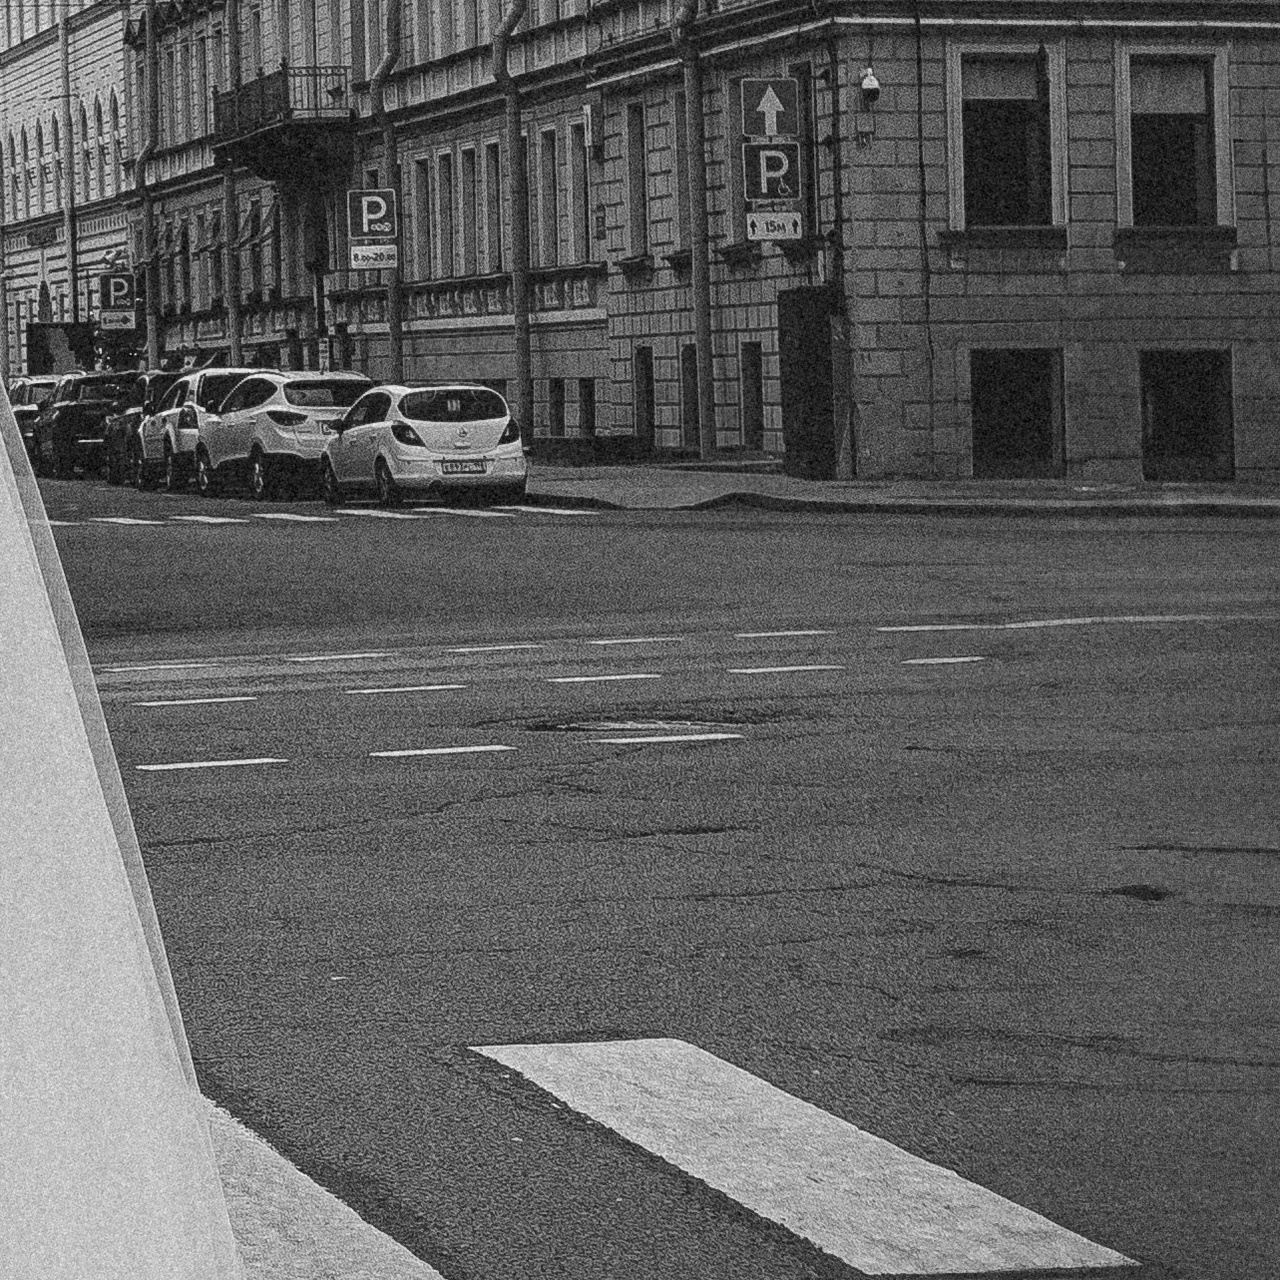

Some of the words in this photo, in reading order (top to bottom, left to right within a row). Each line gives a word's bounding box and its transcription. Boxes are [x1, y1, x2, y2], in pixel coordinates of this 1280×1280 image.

[760, 150, 789, 193] P
[362, 195, 387, 233] P
[110, 278, 128, 306] P
